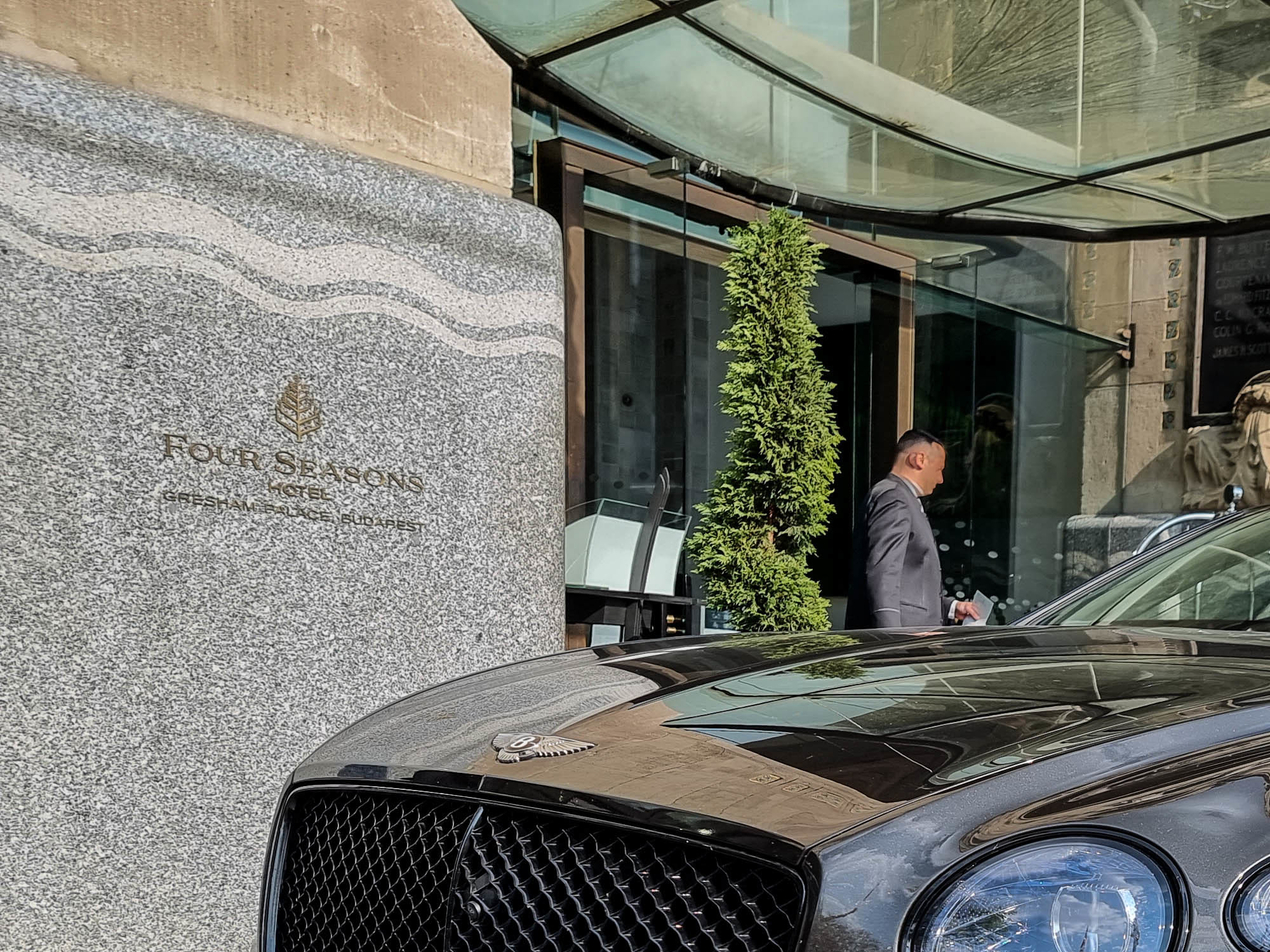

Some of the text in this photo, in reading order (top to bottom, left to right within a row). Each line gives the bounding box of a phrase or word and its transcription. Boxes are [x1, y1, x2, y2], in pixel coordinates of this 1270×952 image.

[163, 433, 425, 493] FOUR SEASONS
[162, 490, 257, 512] GRESHAM
[341, 513, 426, 532] BUDAPEST
[268, 482, 333, 501] HOTEL
